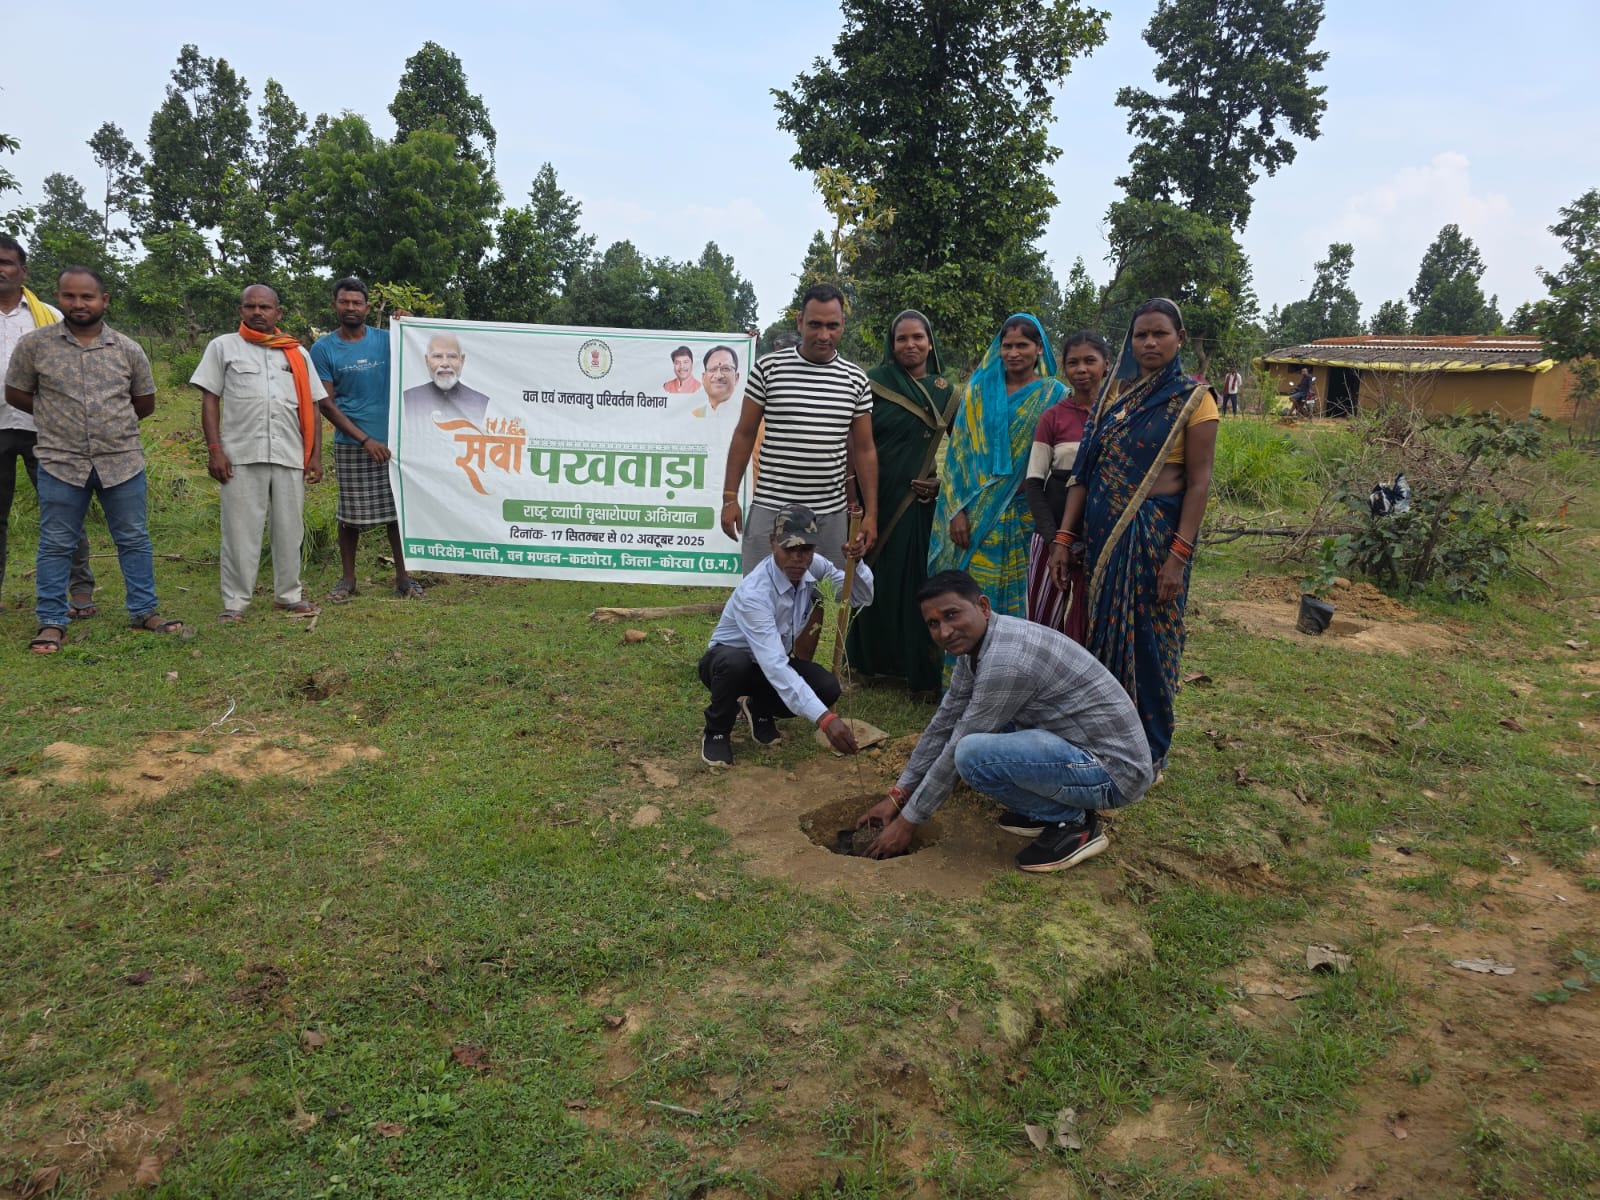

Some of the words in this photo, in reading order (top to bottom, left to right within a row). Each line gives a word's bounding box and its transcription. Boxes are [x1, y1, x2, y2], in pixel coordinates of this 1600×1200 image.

[522, 390, 539, 403] वन
[541, 389, 555, 403] एवं
[557, 391, 594, 410] जलवायु
[596, 389, 634, 408] परिवर्तन
[637, 391, 667, 409] विभाग
[432, 412, 526, 496] सेवा
[528, 447, 708, 500] पखवाड़ा
[523, 505, 549, 521] राष्ट्र
[550, 503, 583, 519] व्यापी
[585, 504, 641, 525] वृक्षारोपण
[644, 506, 698, 524] अभियान
[551, 530, 563, 541] 17
[565, 528, 605, 543] सितम्बर
[607, 529, 617, 543] से
[620, 533, 634, 544] 02
[676, 536, 705, 546] 2025
[408, 543, 425, 556] वन
[506, 550, 524, 562] वन
[620, 552, 695, 569] जिला-कोरबा
[698, 556, 739, 573] (छ.ग.)
